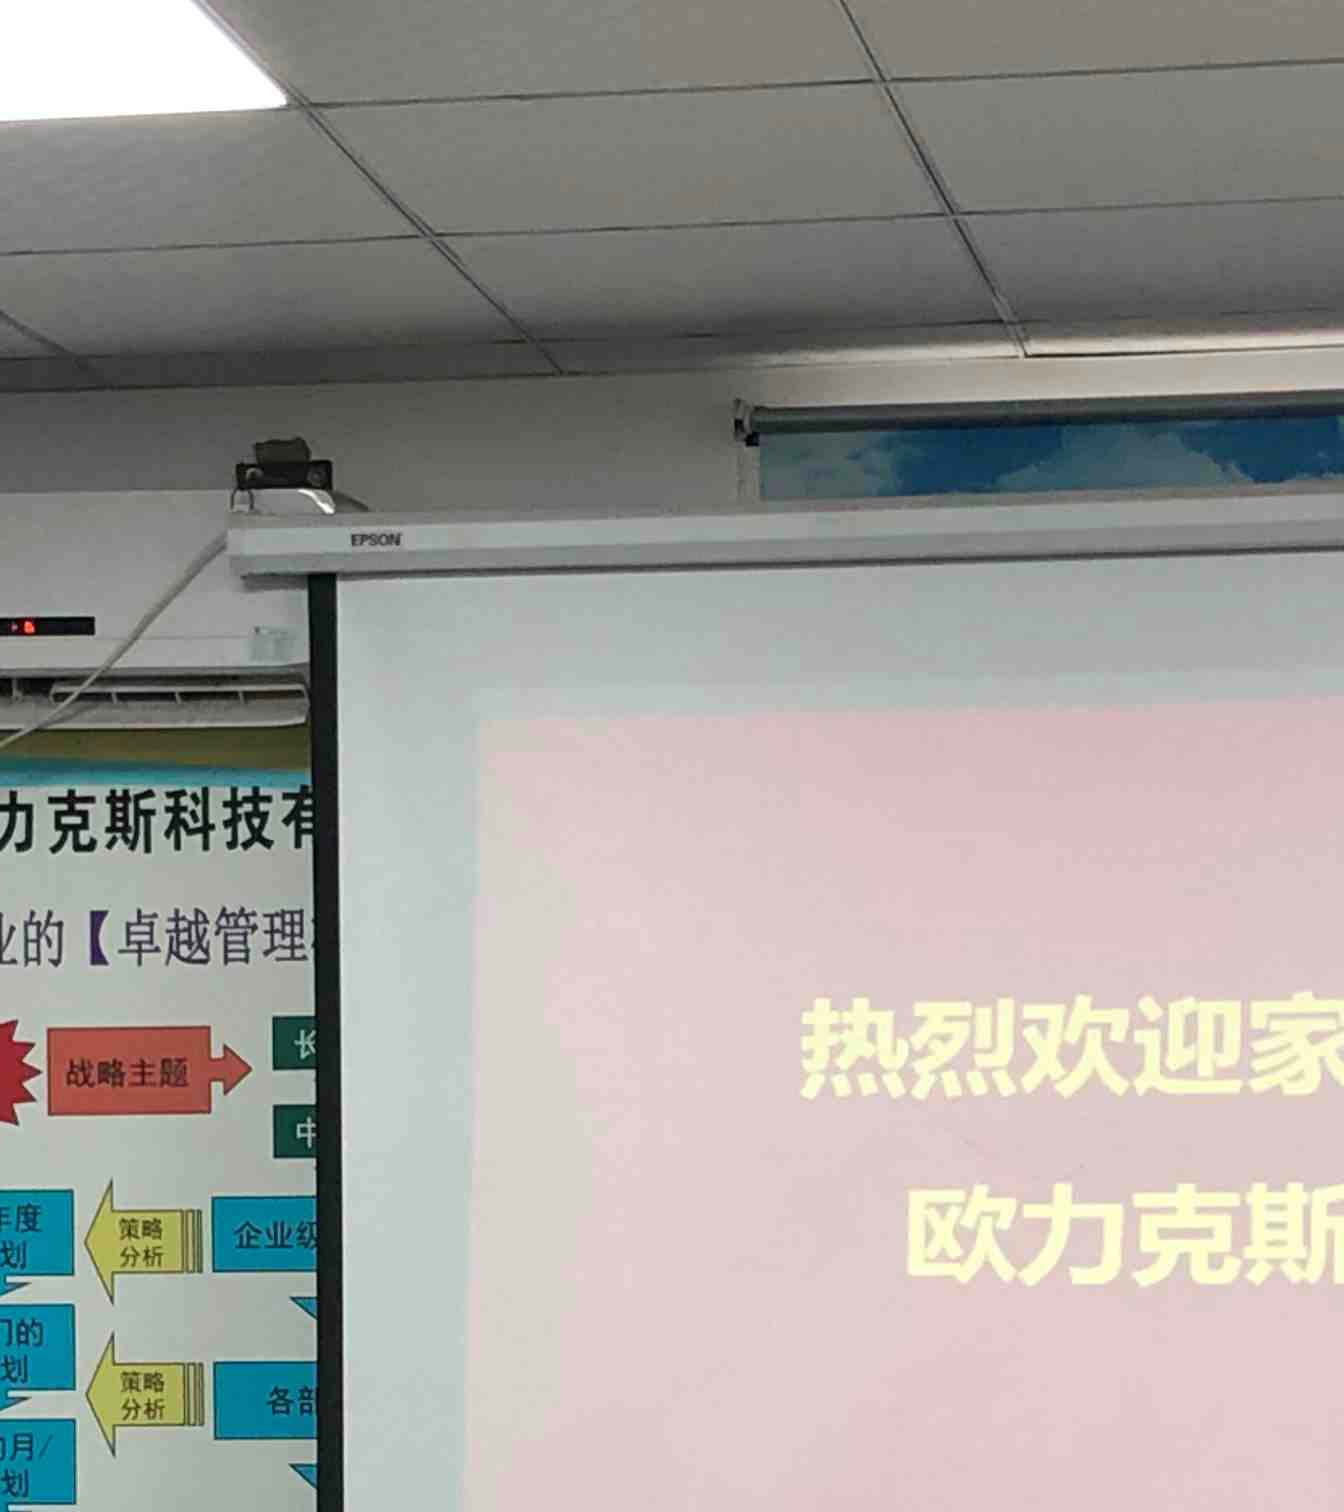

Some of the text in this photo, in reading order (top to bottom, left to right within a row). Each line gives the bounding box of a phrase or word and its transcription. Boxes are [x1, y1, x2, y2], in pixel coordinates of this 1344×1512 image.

[66, 1056, 190, 1090] 战略主题
[119, 1217, 163, 1241] 策略
[119, 1246, 164, 1269] 分析
[120, 1370, 165, 1393] 策略
[121, 1397, 165, 1422] 分析
